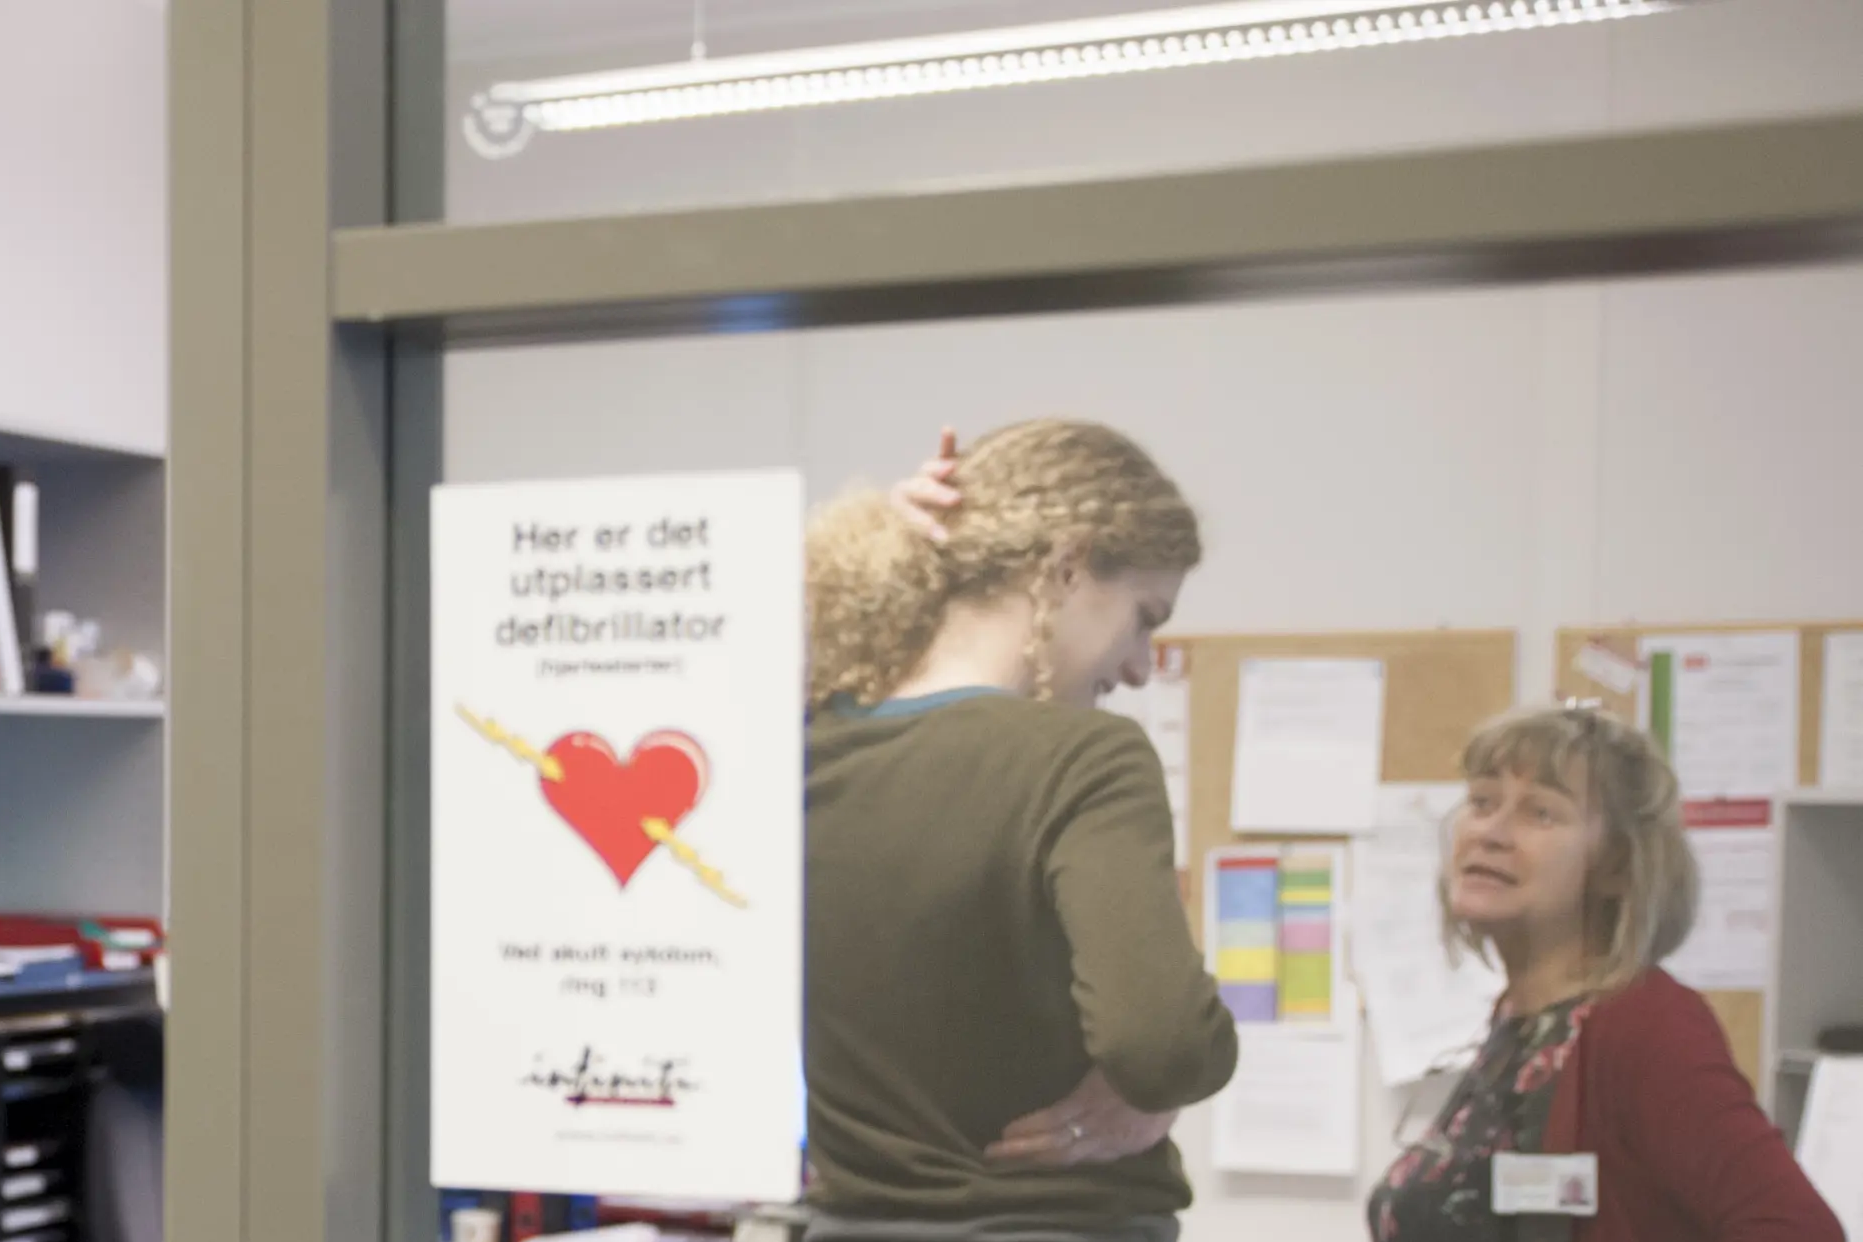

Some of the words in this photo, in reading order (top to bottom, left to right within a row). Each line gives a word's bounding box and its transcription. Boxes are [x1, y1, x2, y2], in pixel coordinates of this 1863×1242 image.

[511, 519, 578, 552] Her
[593, 522, 631, 551] er
[646, 514, 710, 548] det
[509, 560, 712, 603] utplassert
[494, 610, 726, 647] defibrillator
